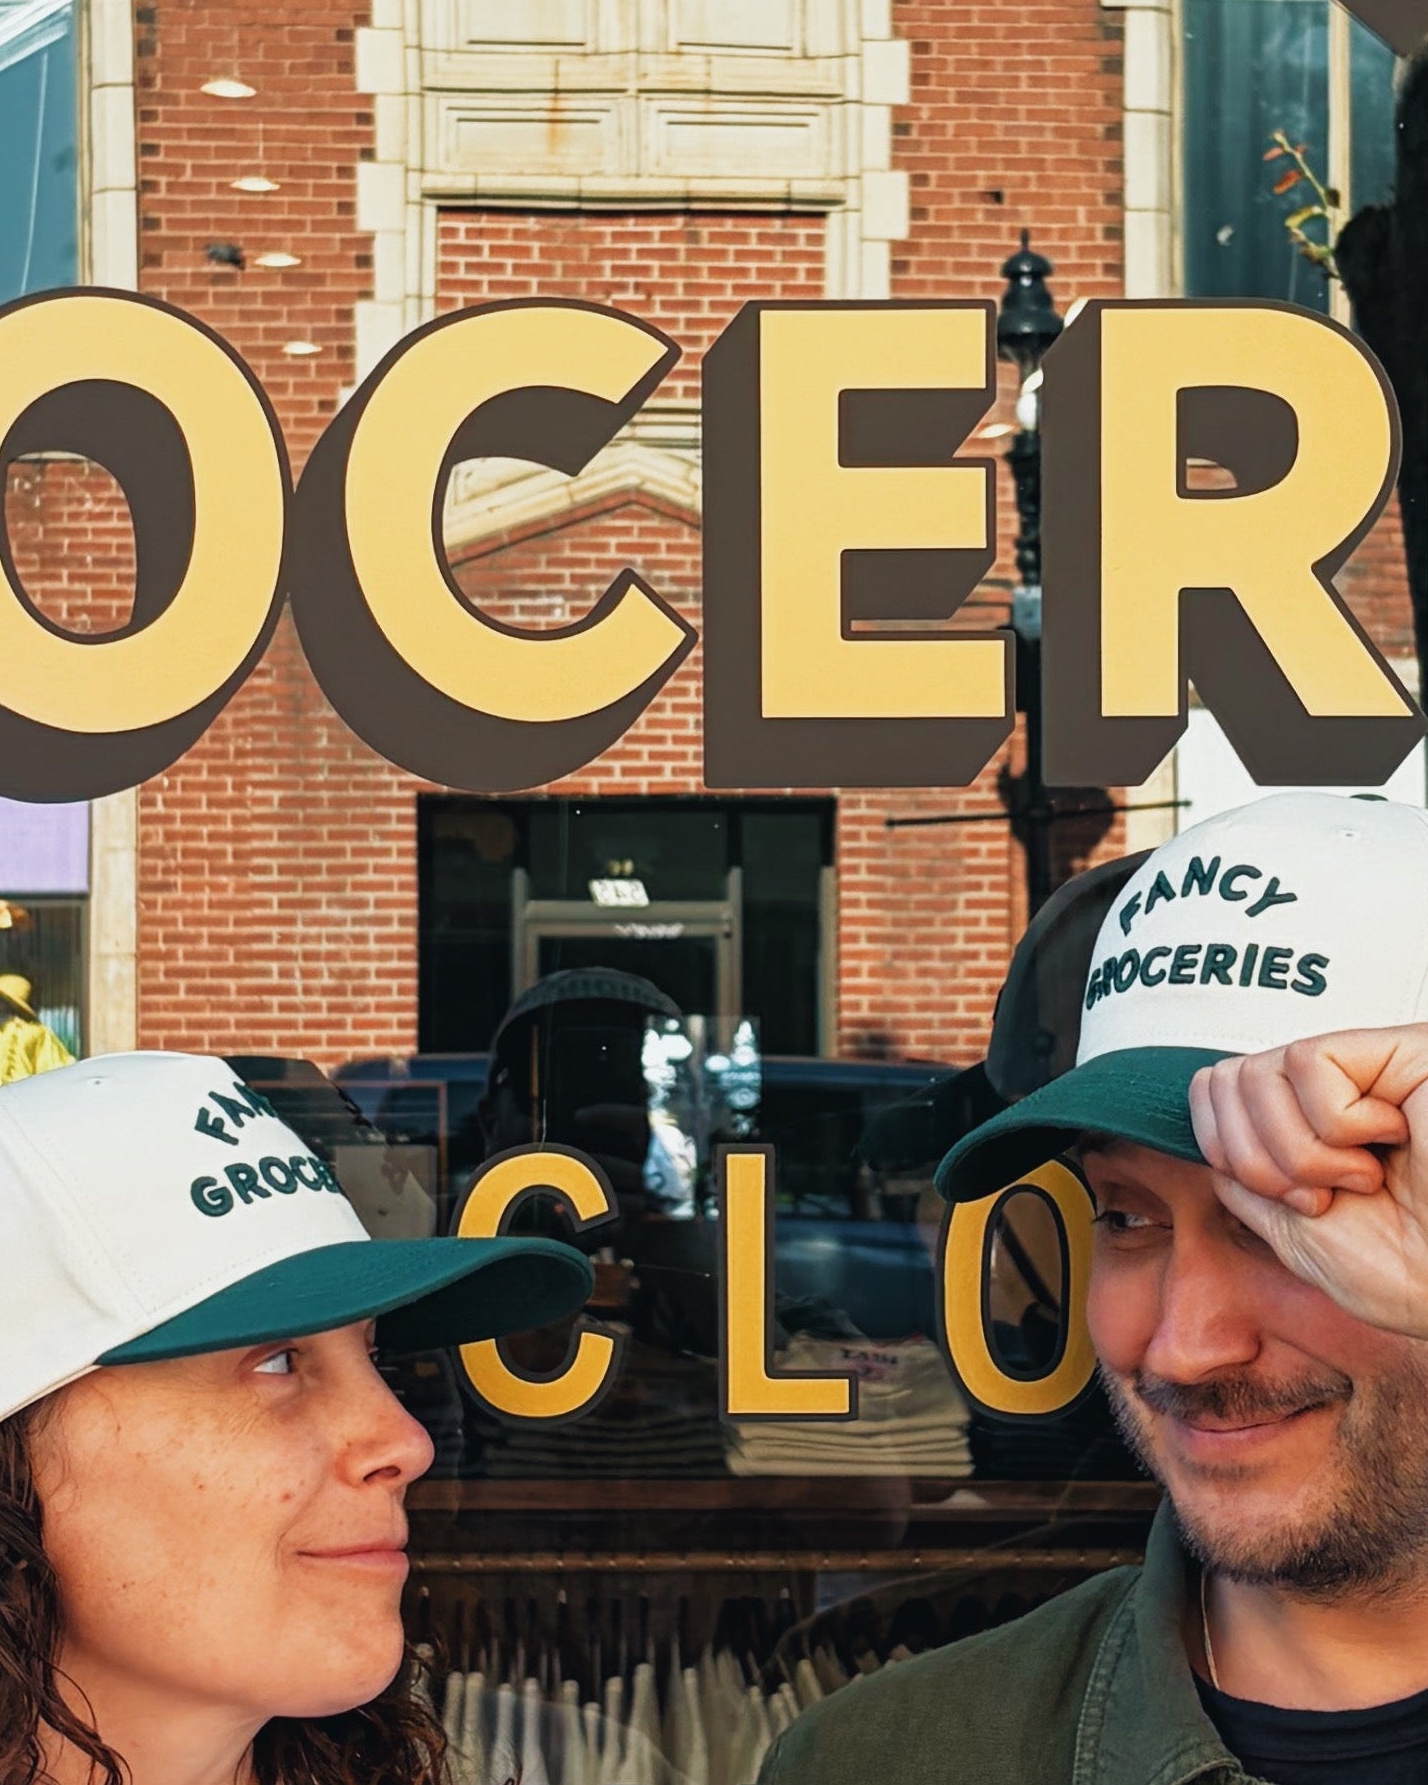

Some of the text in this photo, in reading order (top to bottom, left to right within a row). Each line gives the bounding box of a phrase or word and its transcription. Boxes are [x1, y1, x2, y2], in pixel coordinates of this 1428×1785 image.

[1118, 855, 1298, 936] FANCY
[1085, 942, 1331, 1011] GROCERIES
[194, 1081, 279, 1146] FAN
[189, 1155, 343, 1218] GROCE
